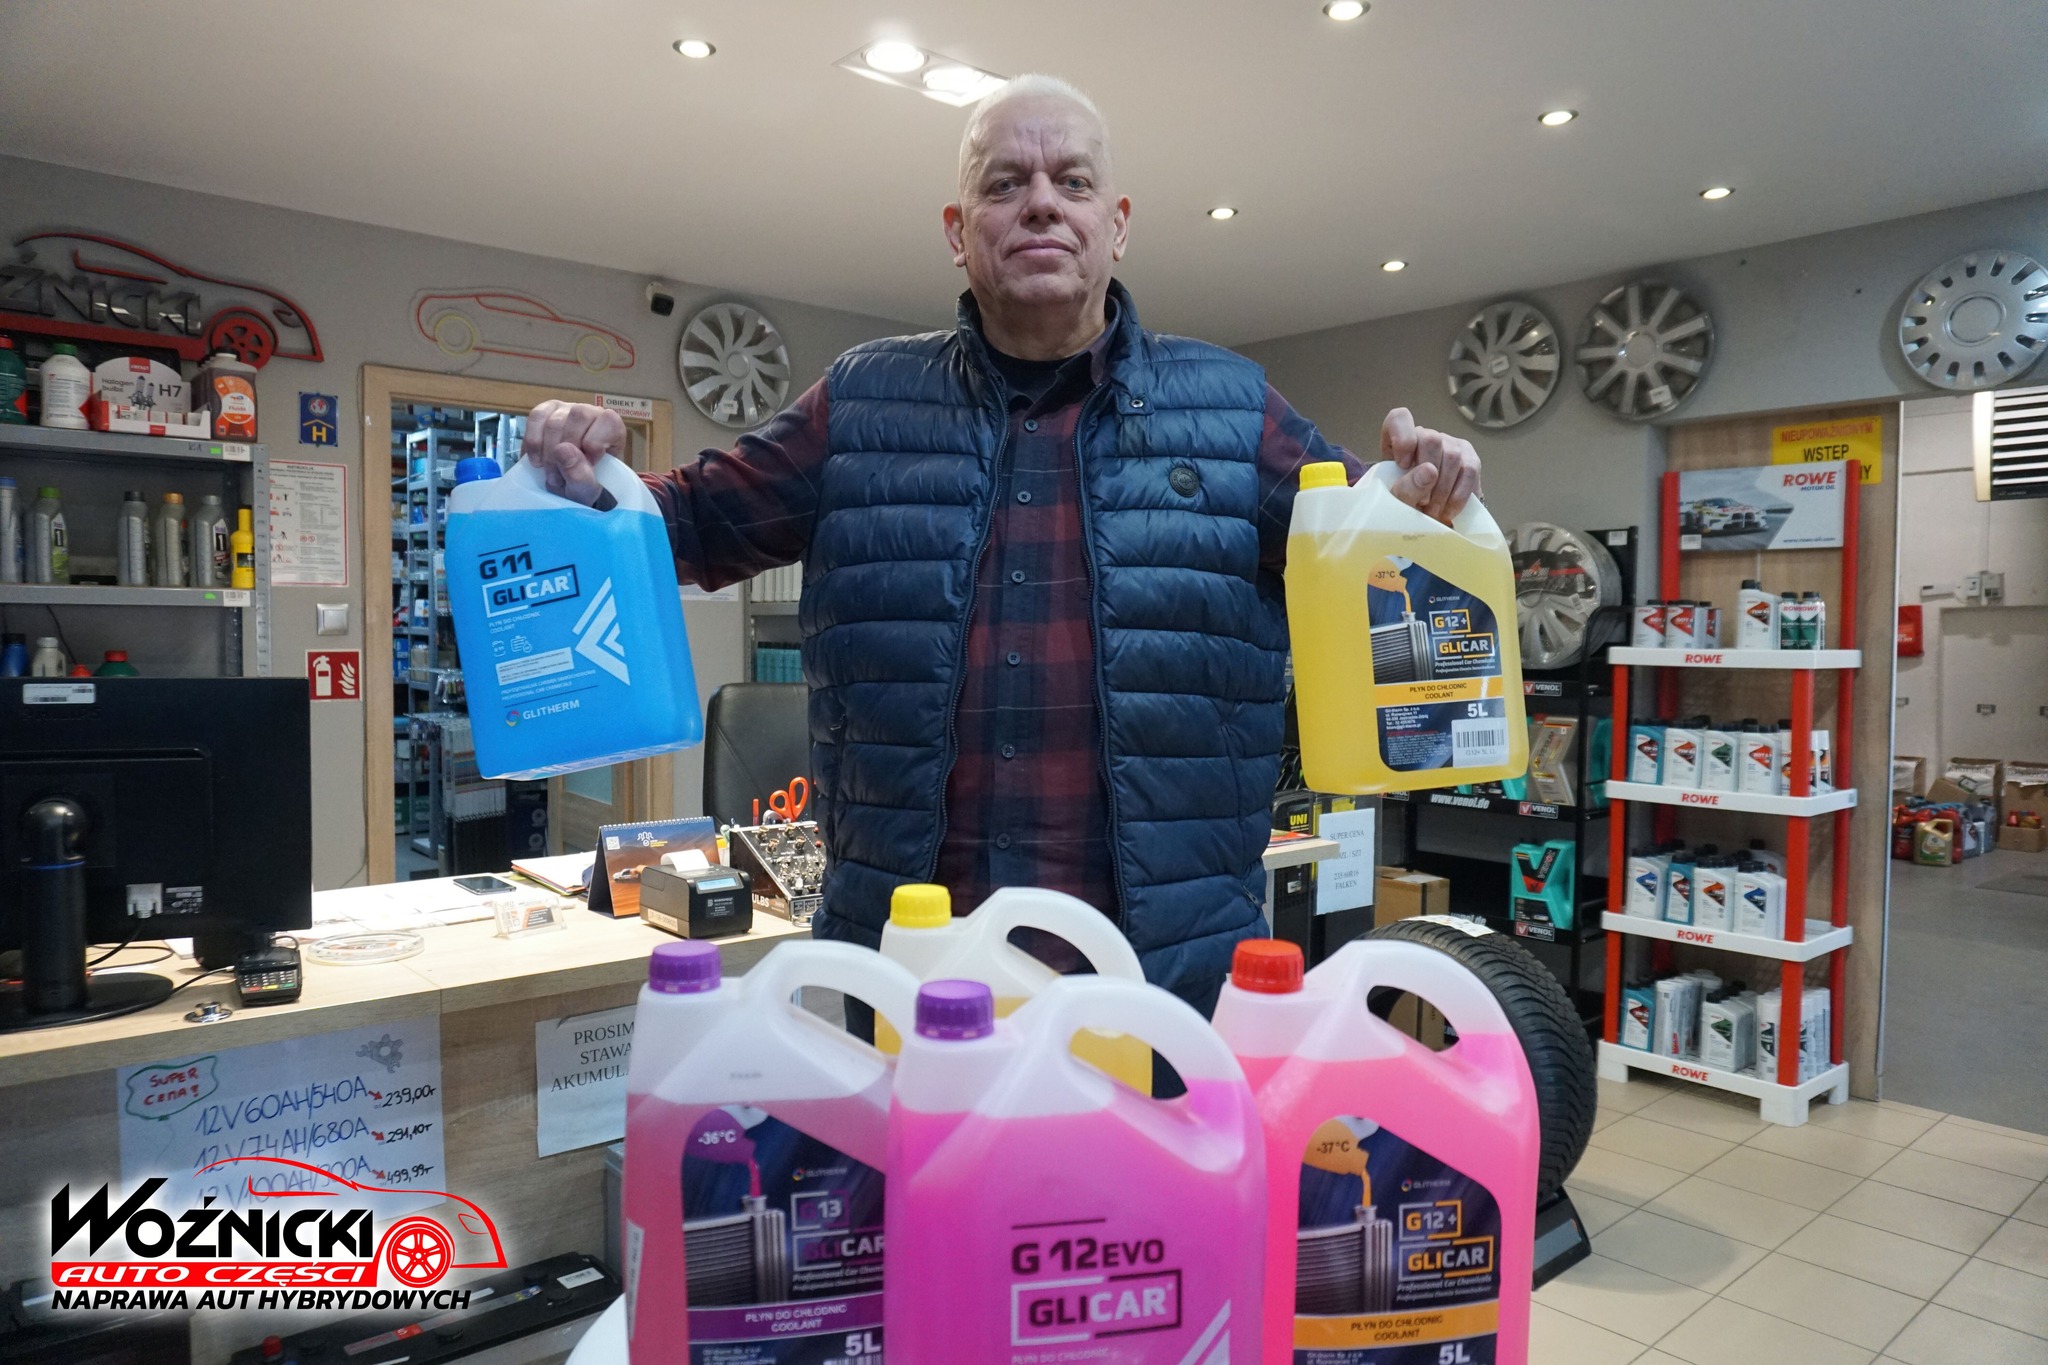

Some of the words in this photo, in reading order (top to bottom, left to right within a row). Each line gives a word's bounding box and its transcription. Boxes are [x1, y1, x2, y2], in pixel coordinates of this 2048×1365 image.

[102, 378, 134, 388] Halogen
[102, 384, 124, 393] bulbs
[159, 384, 182, 398] H7
[606, 399, 635, 407] OBIEKT
[1783, 471, 1837, 487] ROWE
[479, 559, 498, 579] G
[502, 550, 532, 574] 11
[1375, 570, 1396, 579] -37°C
[493, 574, 571, 606] GLICAR
[490, 623, 515, 635] COOLANT
[1440, 640, 1489, 655] GLICAR
[1685, 654, 1723, 664] ROWE
[1535, 683, 1560, 692] VENOL
[1425, 692, 1454, 700] COOLANT
[523, 699, 580, 720] GLITHERM
[1467, 702, 1489, 718] 5L
[1681, 793, 1719, 806] ROWE
[1532, 804, 1557, 814] VENOL
[1289, 813, 1308, 826] UNI
[1330, 832, 1348, 841] SUPER
[1349, 830, 1364, 838] CENA
[1528, 926, 1553, 936] VENOL
[1677, 929, 1714, 944] ROWE
[551, 1063, 629, 1093] AKUMUL
[1671, 1064, 1709, 1082] ROWE
[698, 1129, 737, 1146] -36°C
[1316, 1141, 1350, 1154] -37°C
[1011, 1243, 1041, 1275] G
[1408, 1246, 1485, 1272] GLICAR
[1397, 1281, 1443, 1293] Professional
[1444, 1279, 1457, 1288] Car
[1457, 1274, 1492, 1287] Chemicals
[1028, 1285, 1167, 1328] GLICAR
[745, 1311, 773, 1323] PŁYN
[774, 1309, 791, 1321] DO
[771, 1318, 823, 1333] COOLANT
[1351, 1322, 1377, 1331] PŁYN
[1378, 1320, 1393, 1330] DO
[1374, 1329, 1420, 1341] COOLANT
[845, 1331, 882, 1357] 5L
[1439, 1342, 1471, 1365] 5L
